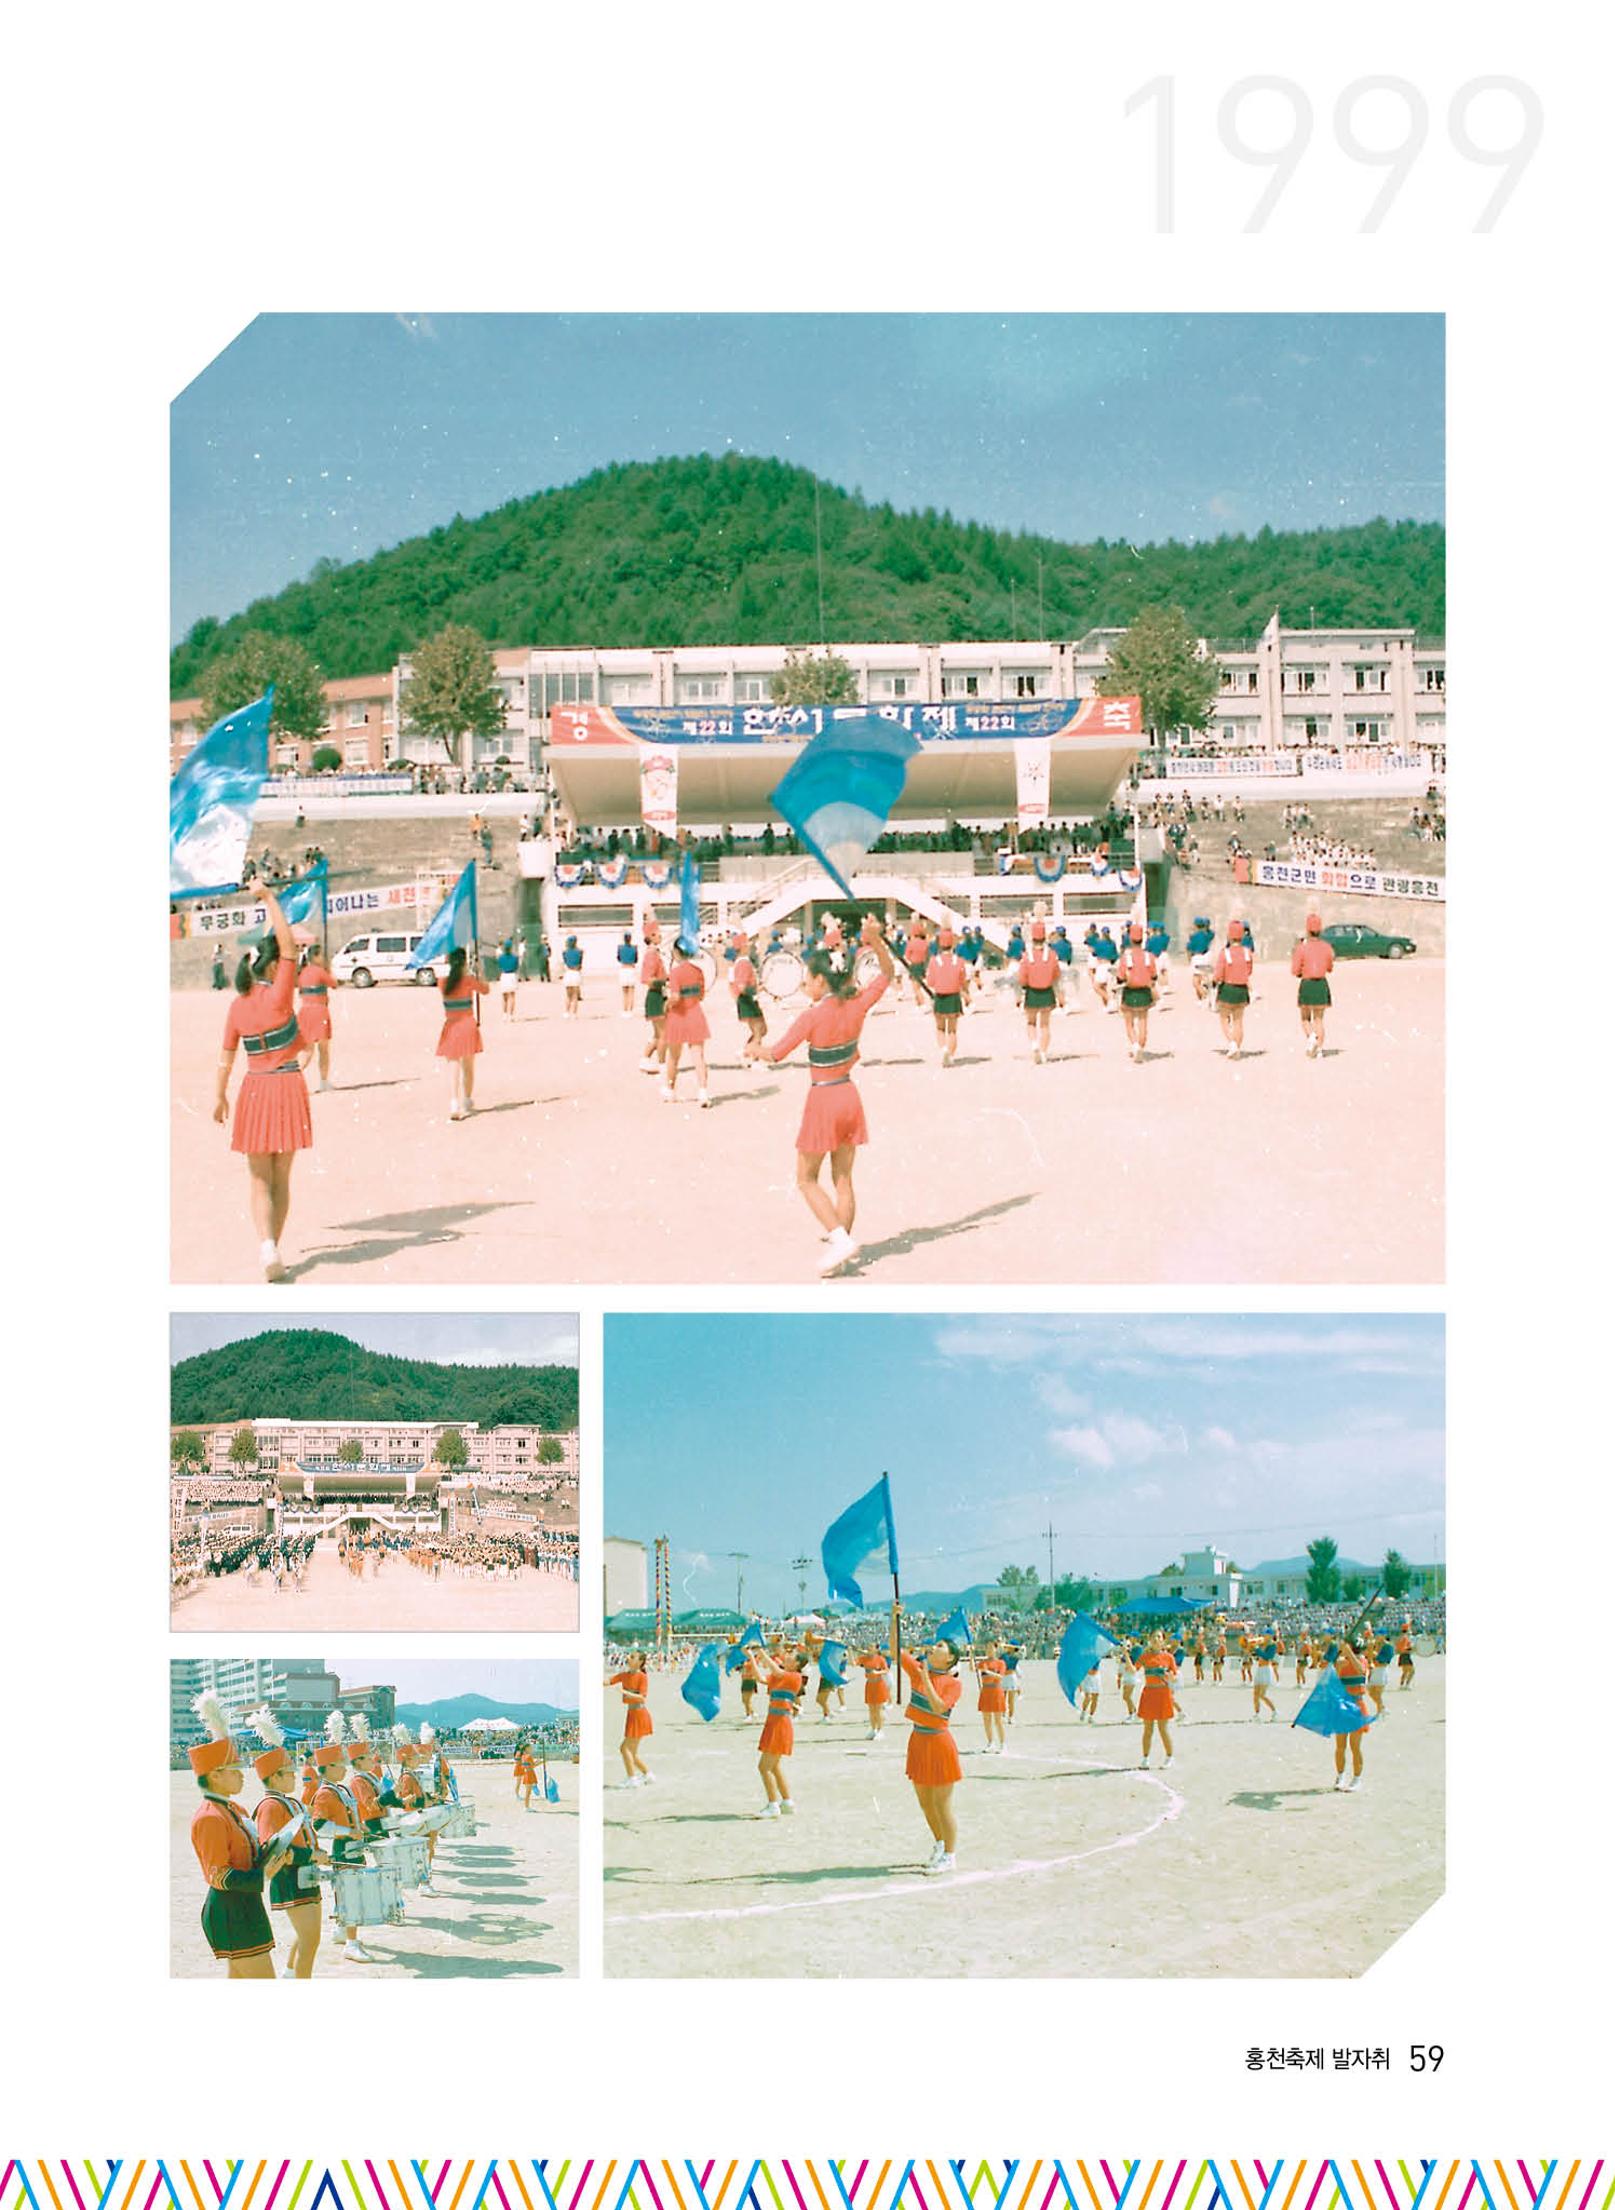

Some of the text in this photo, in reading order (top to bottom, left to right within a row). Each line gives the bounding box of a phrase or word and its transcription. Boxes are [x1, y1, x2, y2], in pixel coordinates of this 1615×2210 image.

[559, 710, 589, 741] 경
[682, 720, 733, 736] 제22회
[965, 714, 1016, 732] 제22회
[1103, 701, 1131, 731] 축
[1262, 864, 1317, 885] 홍천군민
[1382, 876, 1439, 897] 관광홍천
[200, 910, 246, 931] 무궁화
